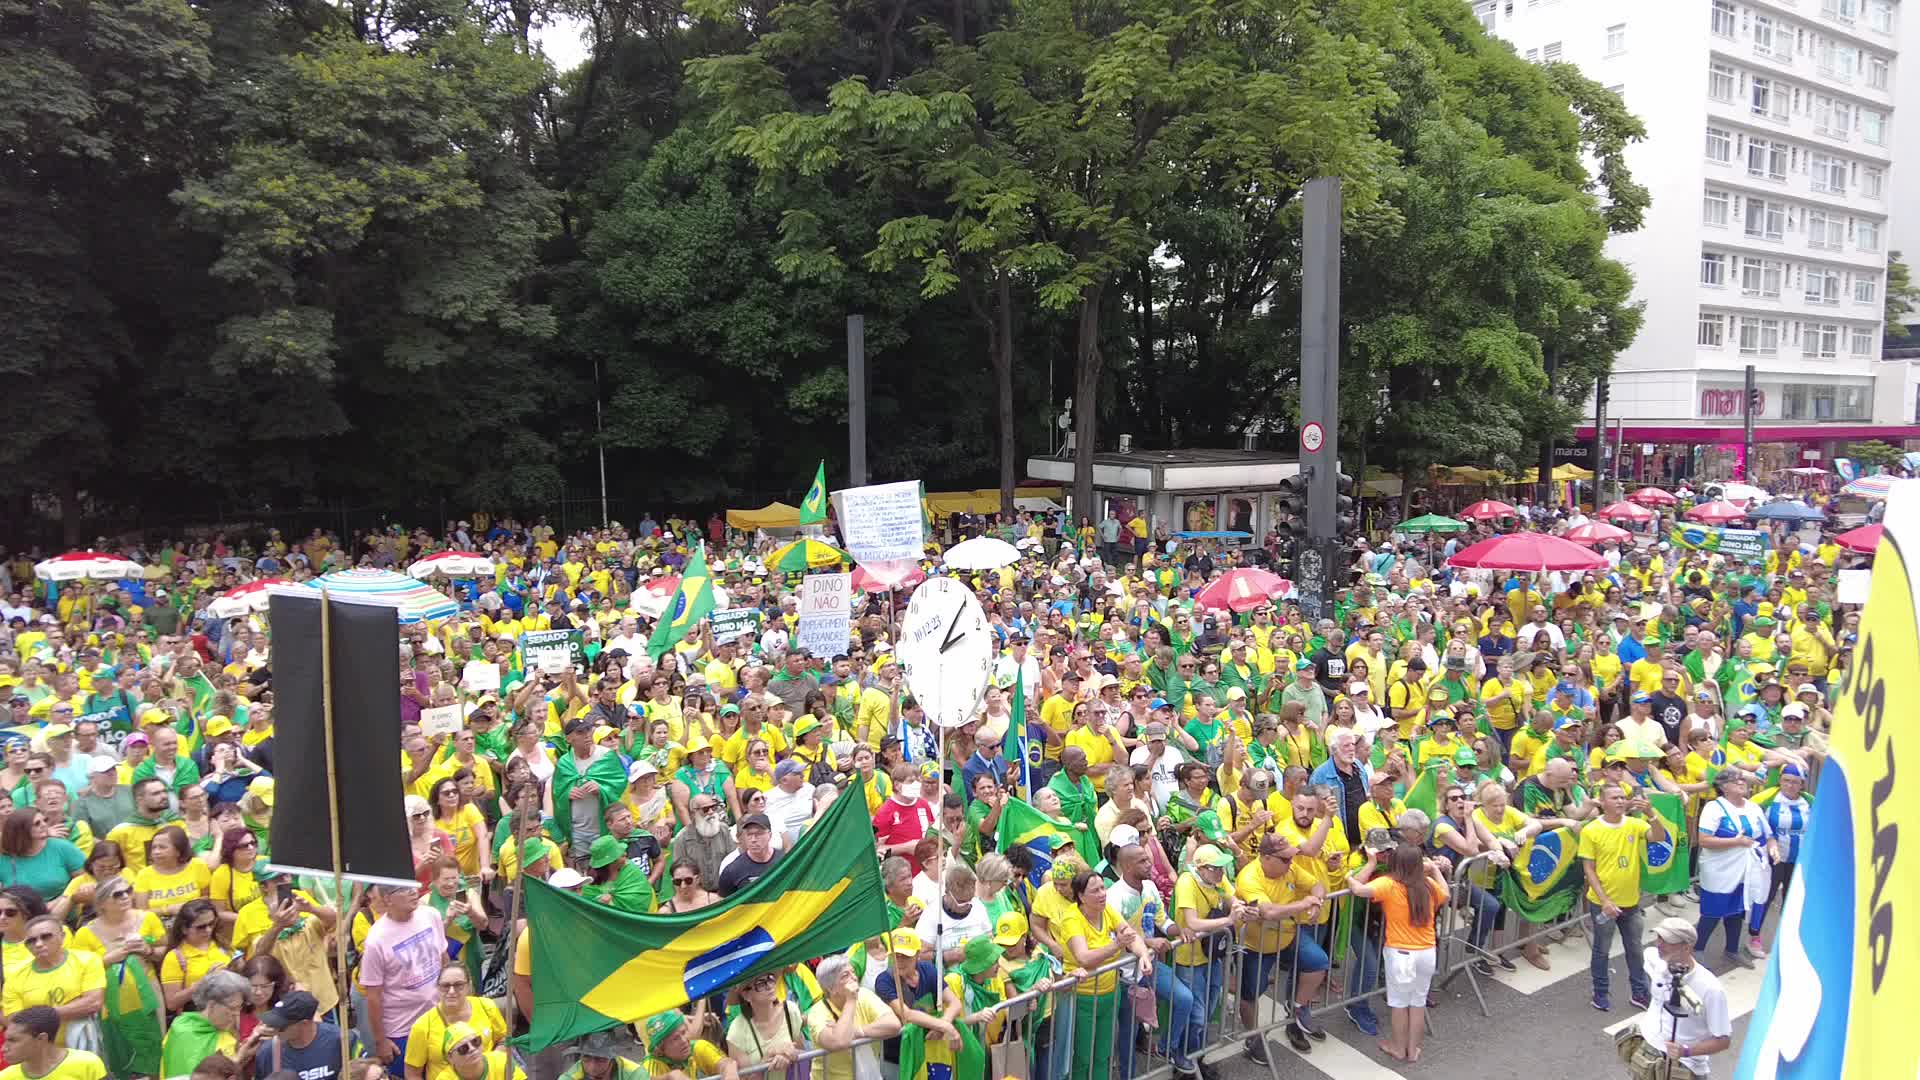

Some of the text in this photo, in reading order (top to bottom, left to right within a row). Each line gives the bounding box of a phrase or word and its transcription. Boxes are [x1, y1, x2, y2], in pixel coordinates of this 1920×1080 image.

[1555, 447, 1588, 457] marisa
[1720, 540, 1762, 551] DINO NÃO
[813, 578, 843, 593] DINO
[920, 586, 927, 598] 11
[939, 580, 948, 592] 12
[814, 593, 840, 609] NÃO
[911, 601, 918, 614] 10
[713, 611, 749, 622] SENADO
[712, 619, 756, 633] DINO NÃO
[975, 617, 981, 631] 2
[527, 632, 569, 644] SENADO
[555, 640, 579, 653] NÃO
[980, 657, 987, 671] 3
[957, 709, 963, 722] 5
